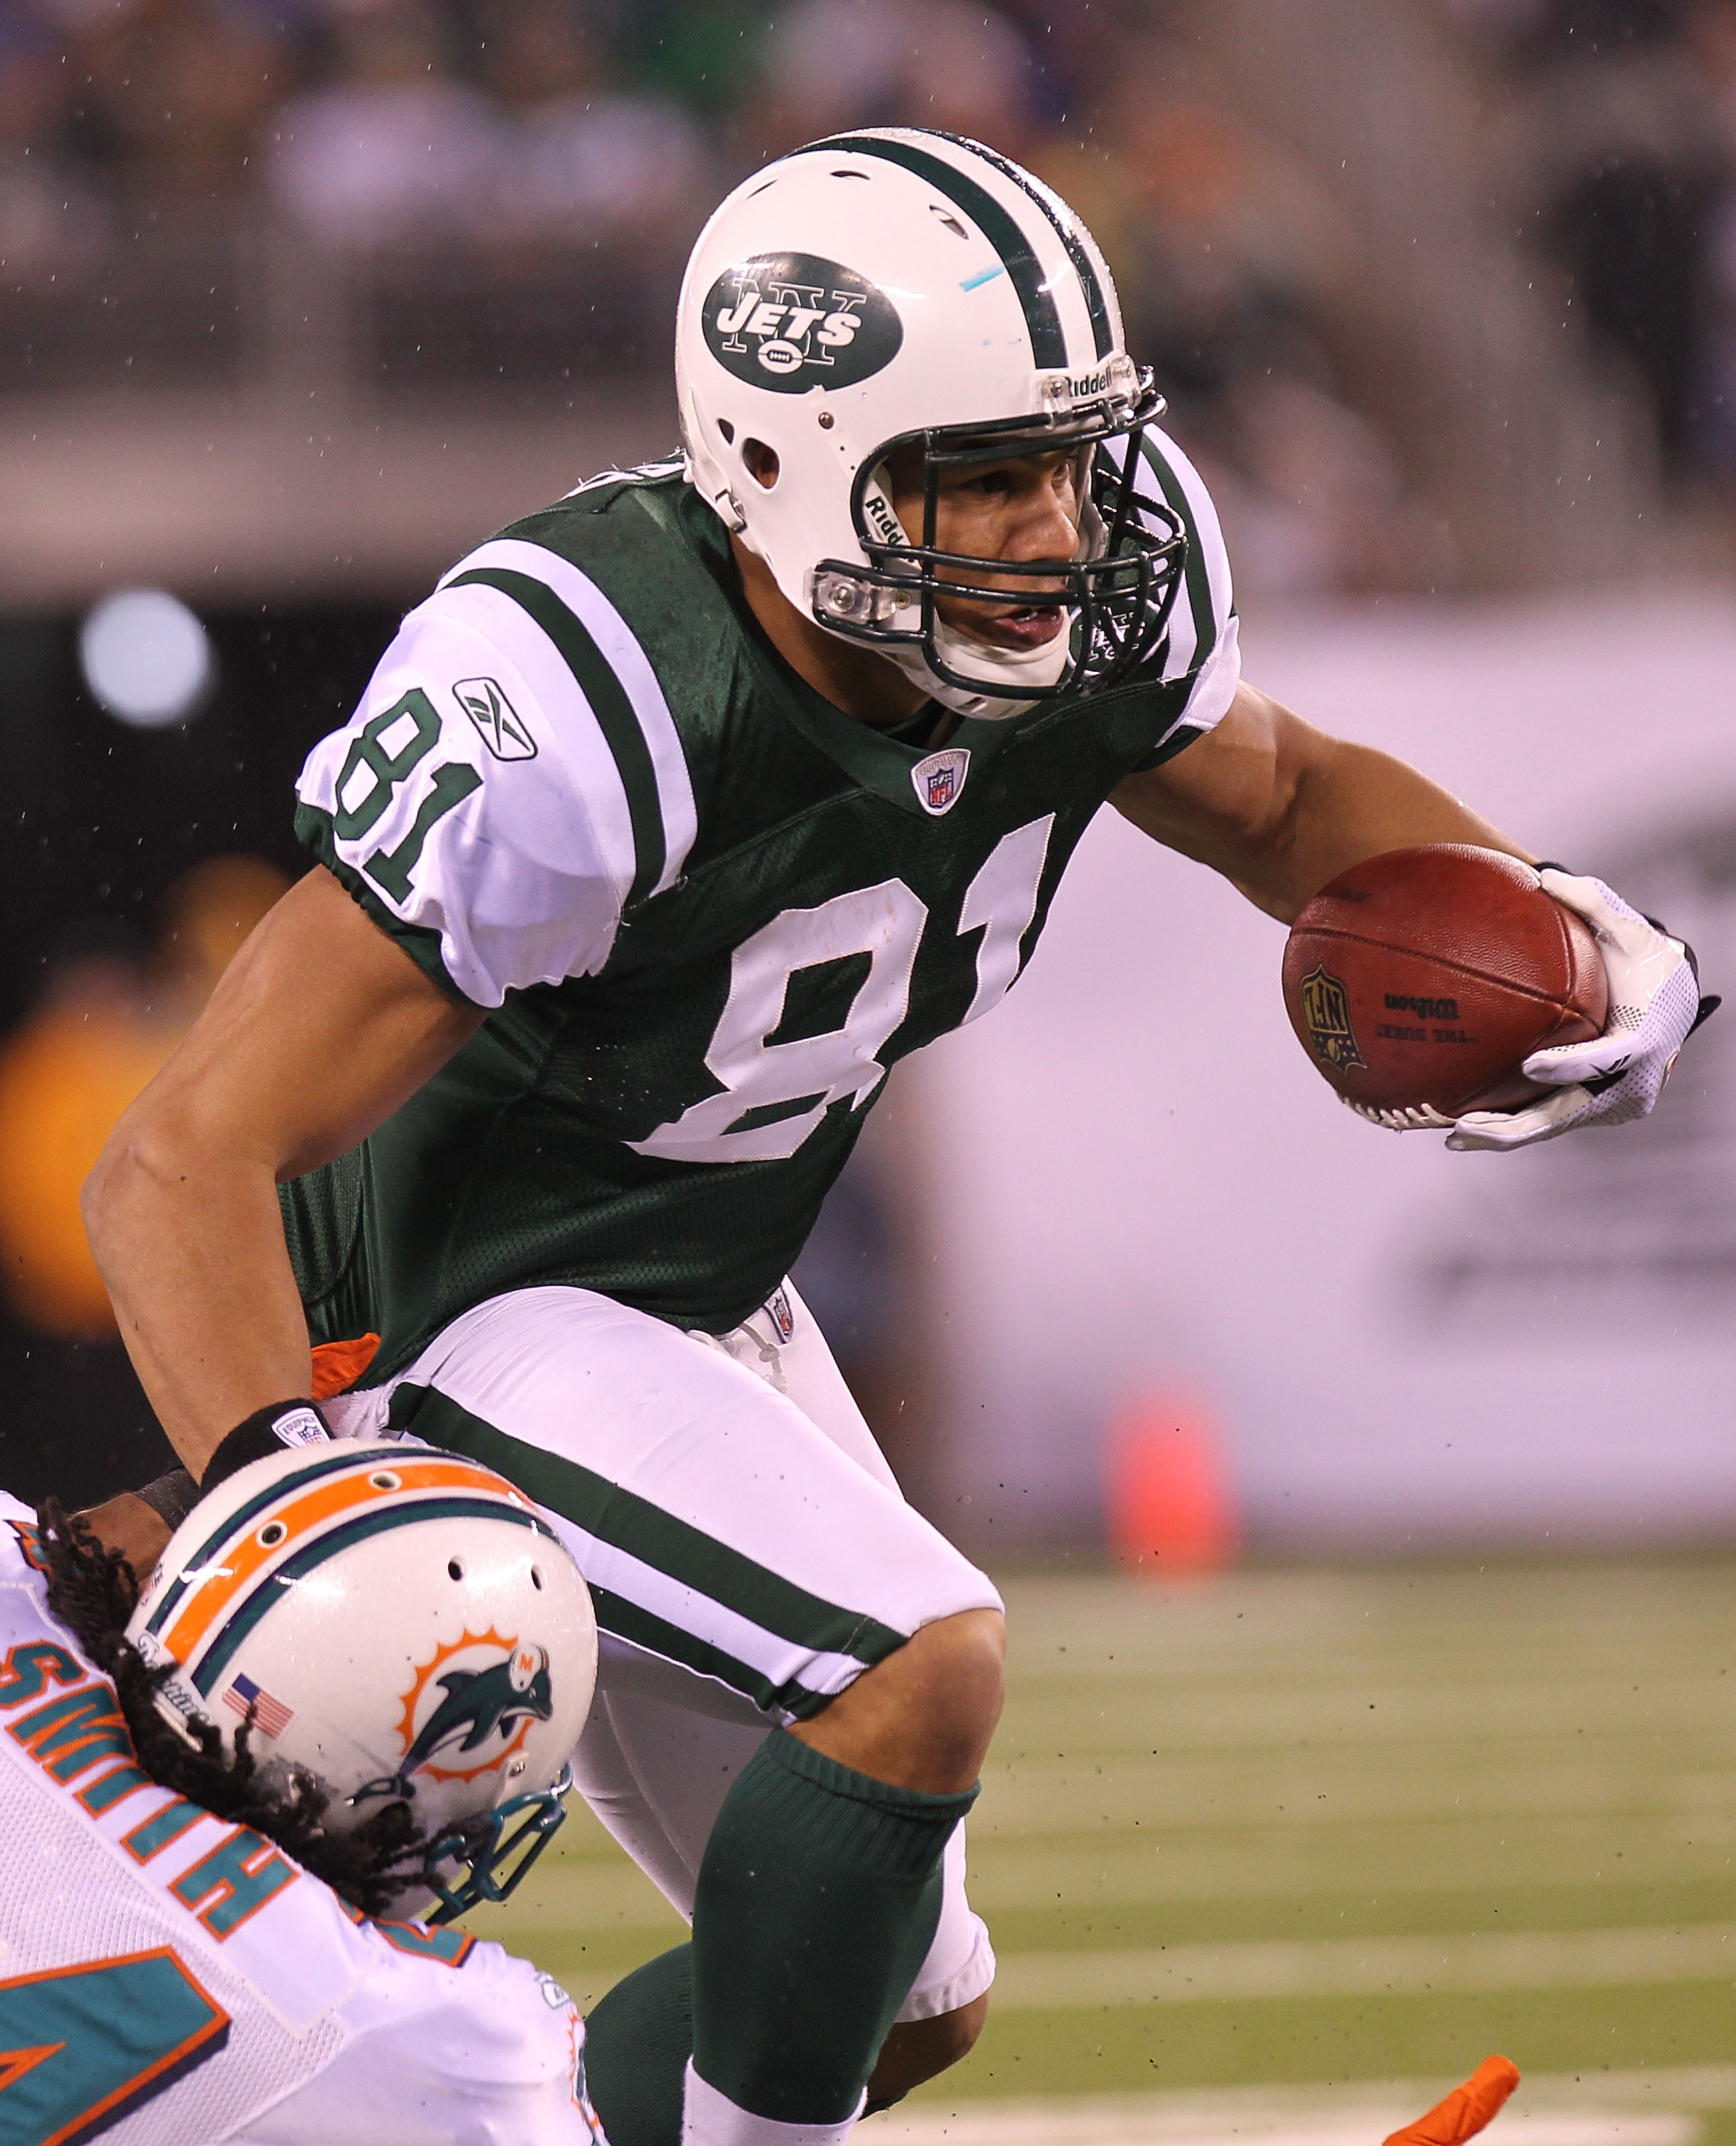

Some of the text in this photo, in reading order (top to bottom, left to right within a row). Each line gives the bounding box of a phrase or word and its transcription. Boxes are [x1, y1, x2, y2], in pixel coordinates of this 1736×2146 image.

[716, 292, 862, 346] JETS
[332, 687, 485, 906] 81
[620, 811, 1056, 1163] 81
[1303, 980, 1349, 1033] NFL
[1384, 993, 1459, 1019] Wilson
[519, 1652, 534, 1672] M
[0, 1639, 303, 1942] SMITH
